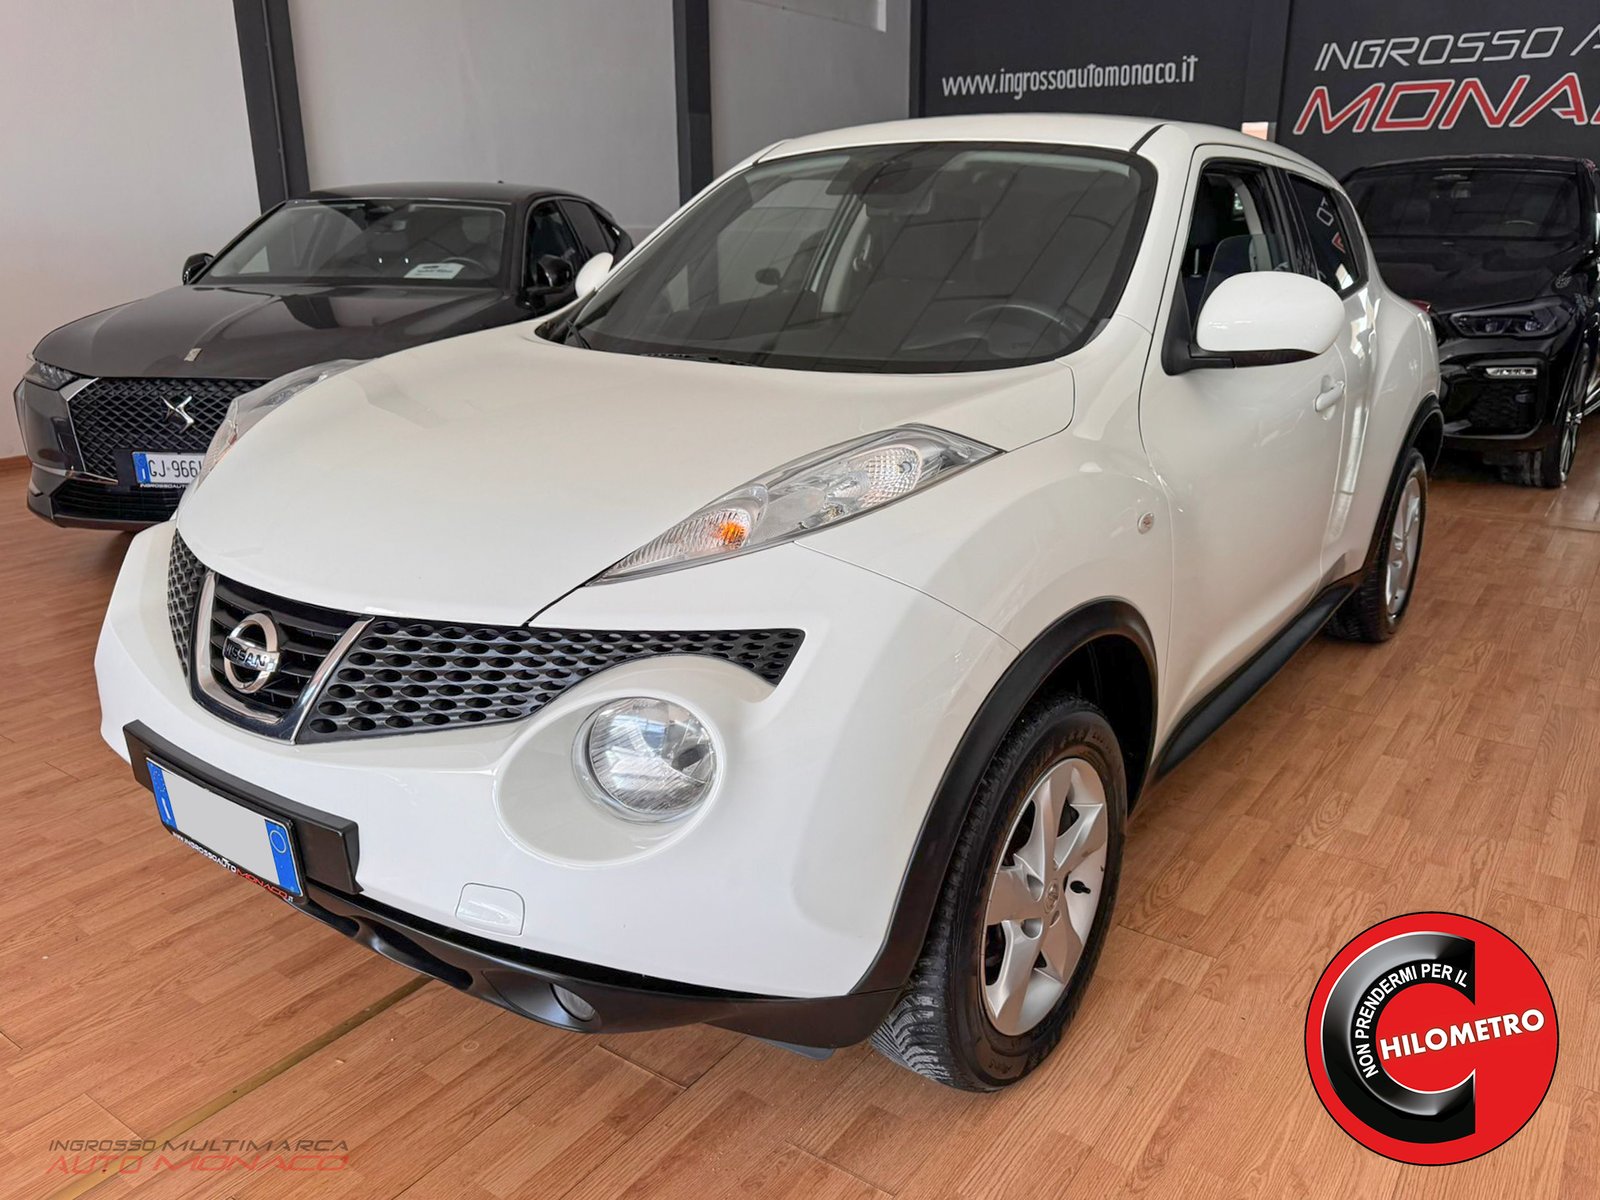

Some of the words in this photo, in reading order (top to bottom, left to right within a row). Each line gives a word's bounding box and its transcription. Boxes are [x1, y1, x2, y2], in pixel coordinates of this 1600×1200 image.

[1314, 26, 1564, 71] INGROSSO
[942, 55, 1199, 100] www.ingrossoautomonaco.it
[1293, 71, 1600, 135] MONA
[225, 642, 268, 668] NISSAN
